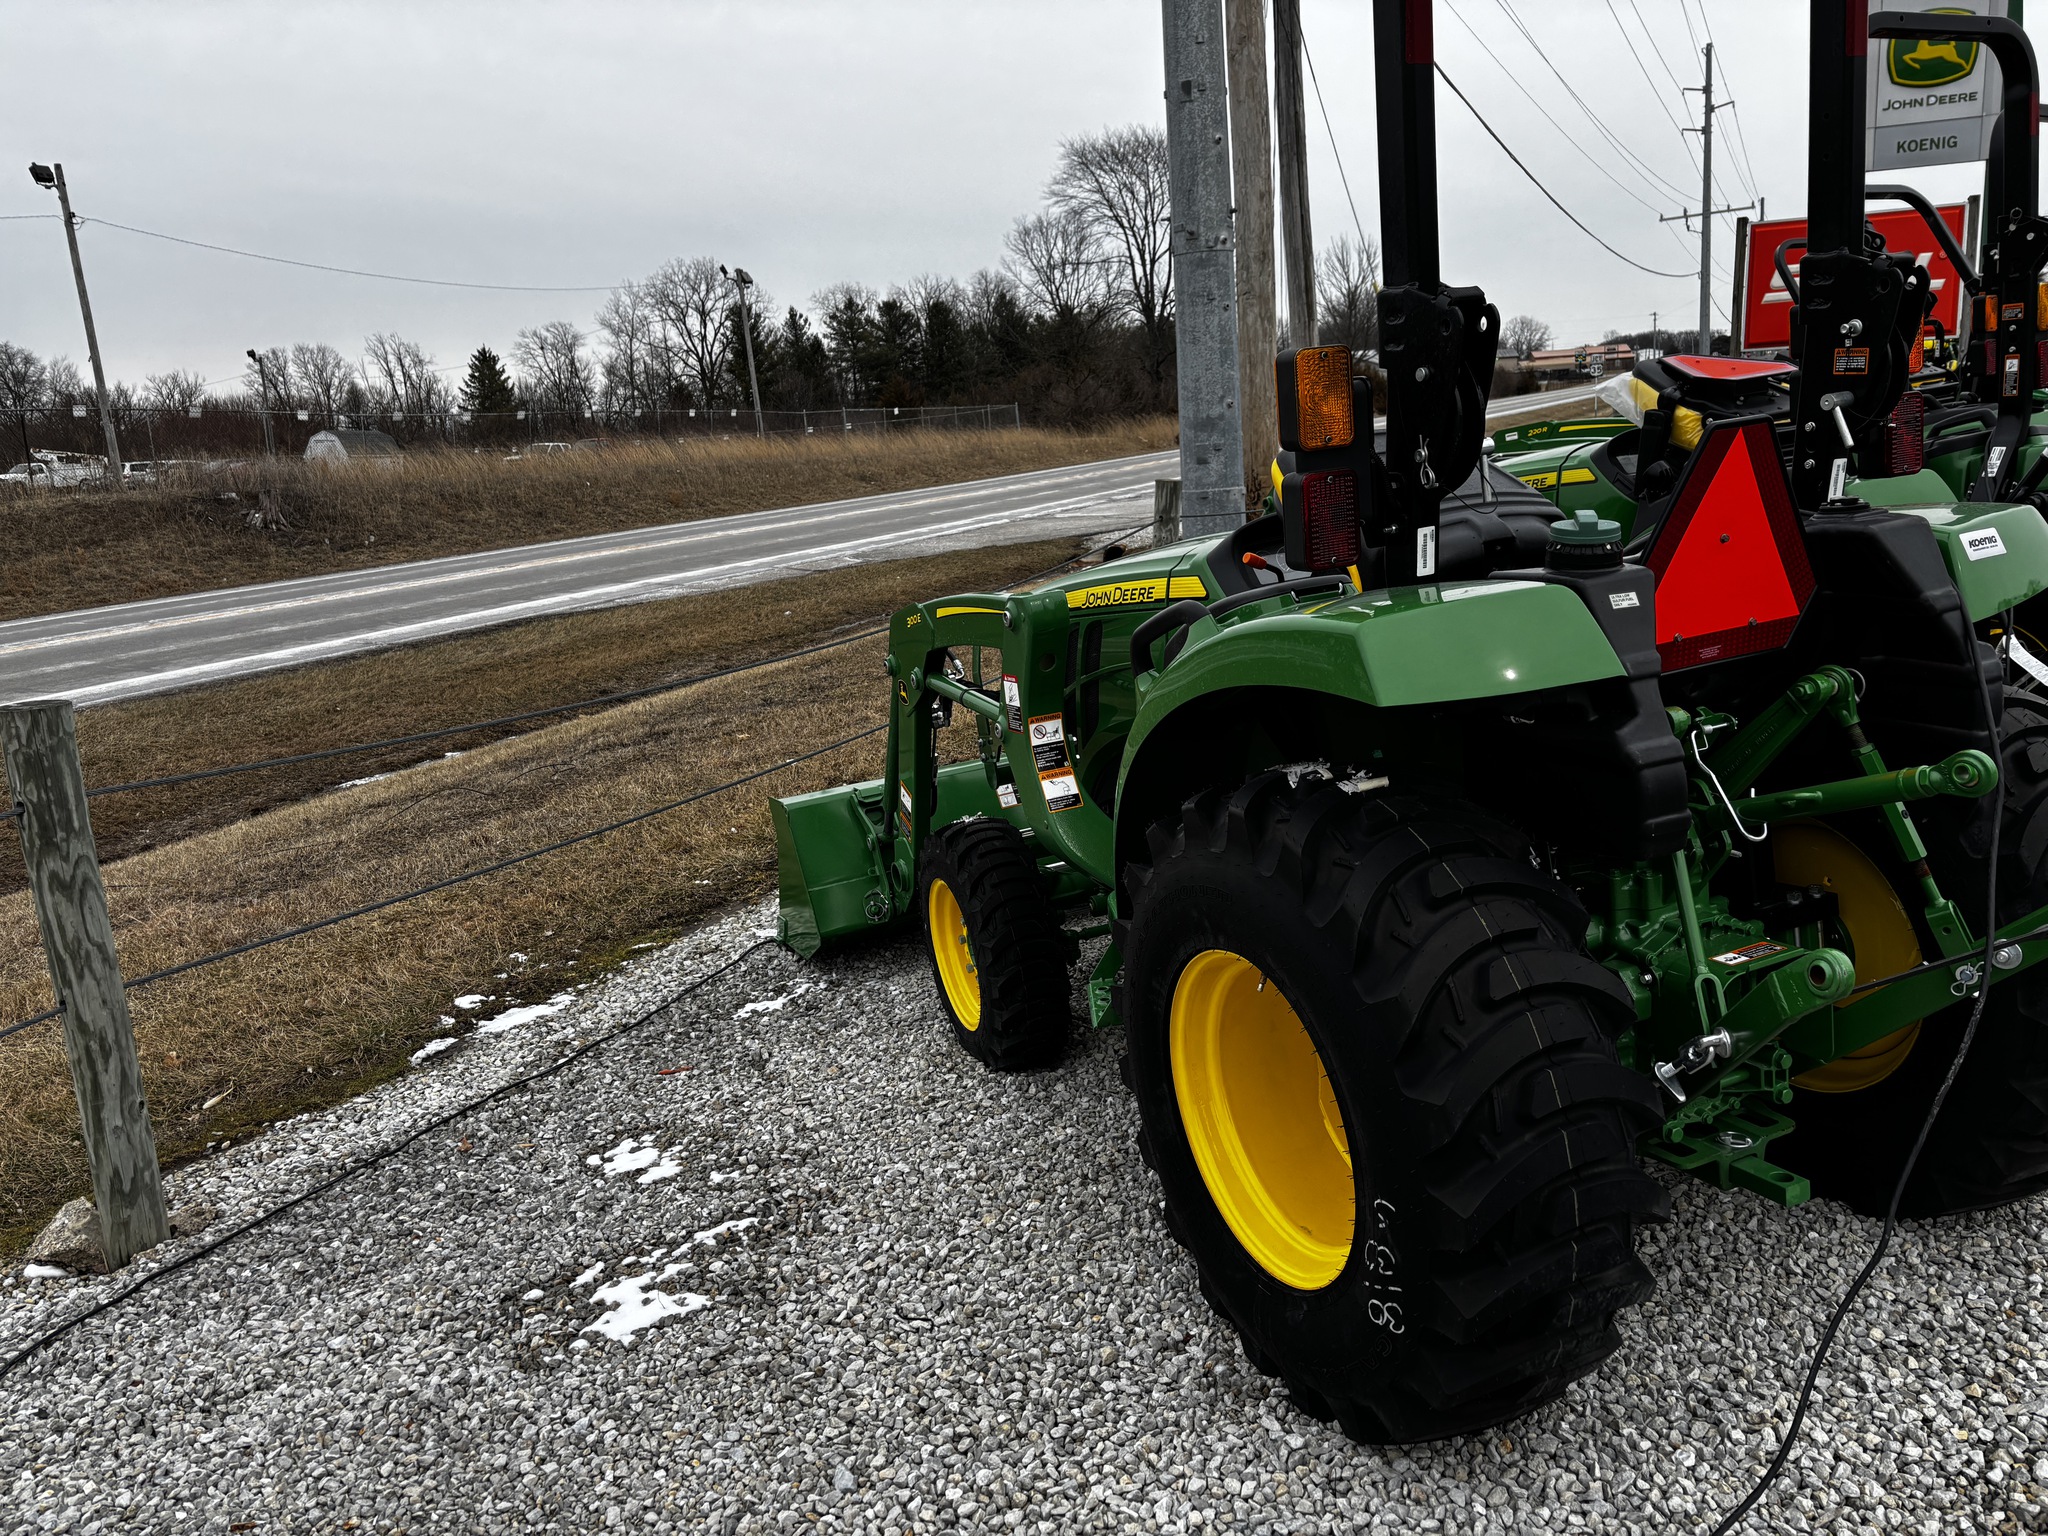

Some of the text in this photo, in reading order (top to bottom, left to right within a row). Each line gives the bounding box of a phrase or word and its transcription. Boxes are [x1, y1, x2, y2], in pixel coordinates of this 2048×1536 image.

[1882, 91, 1978, 111] JOHN DEERE
[1896, 135, 1958, 154] KOENIG
[1082, 586, 1155, 607] JOHN DEERE
[1035, 713, 1061, 723] WARNING
[1046, 769, 1072, 779] WARNING
